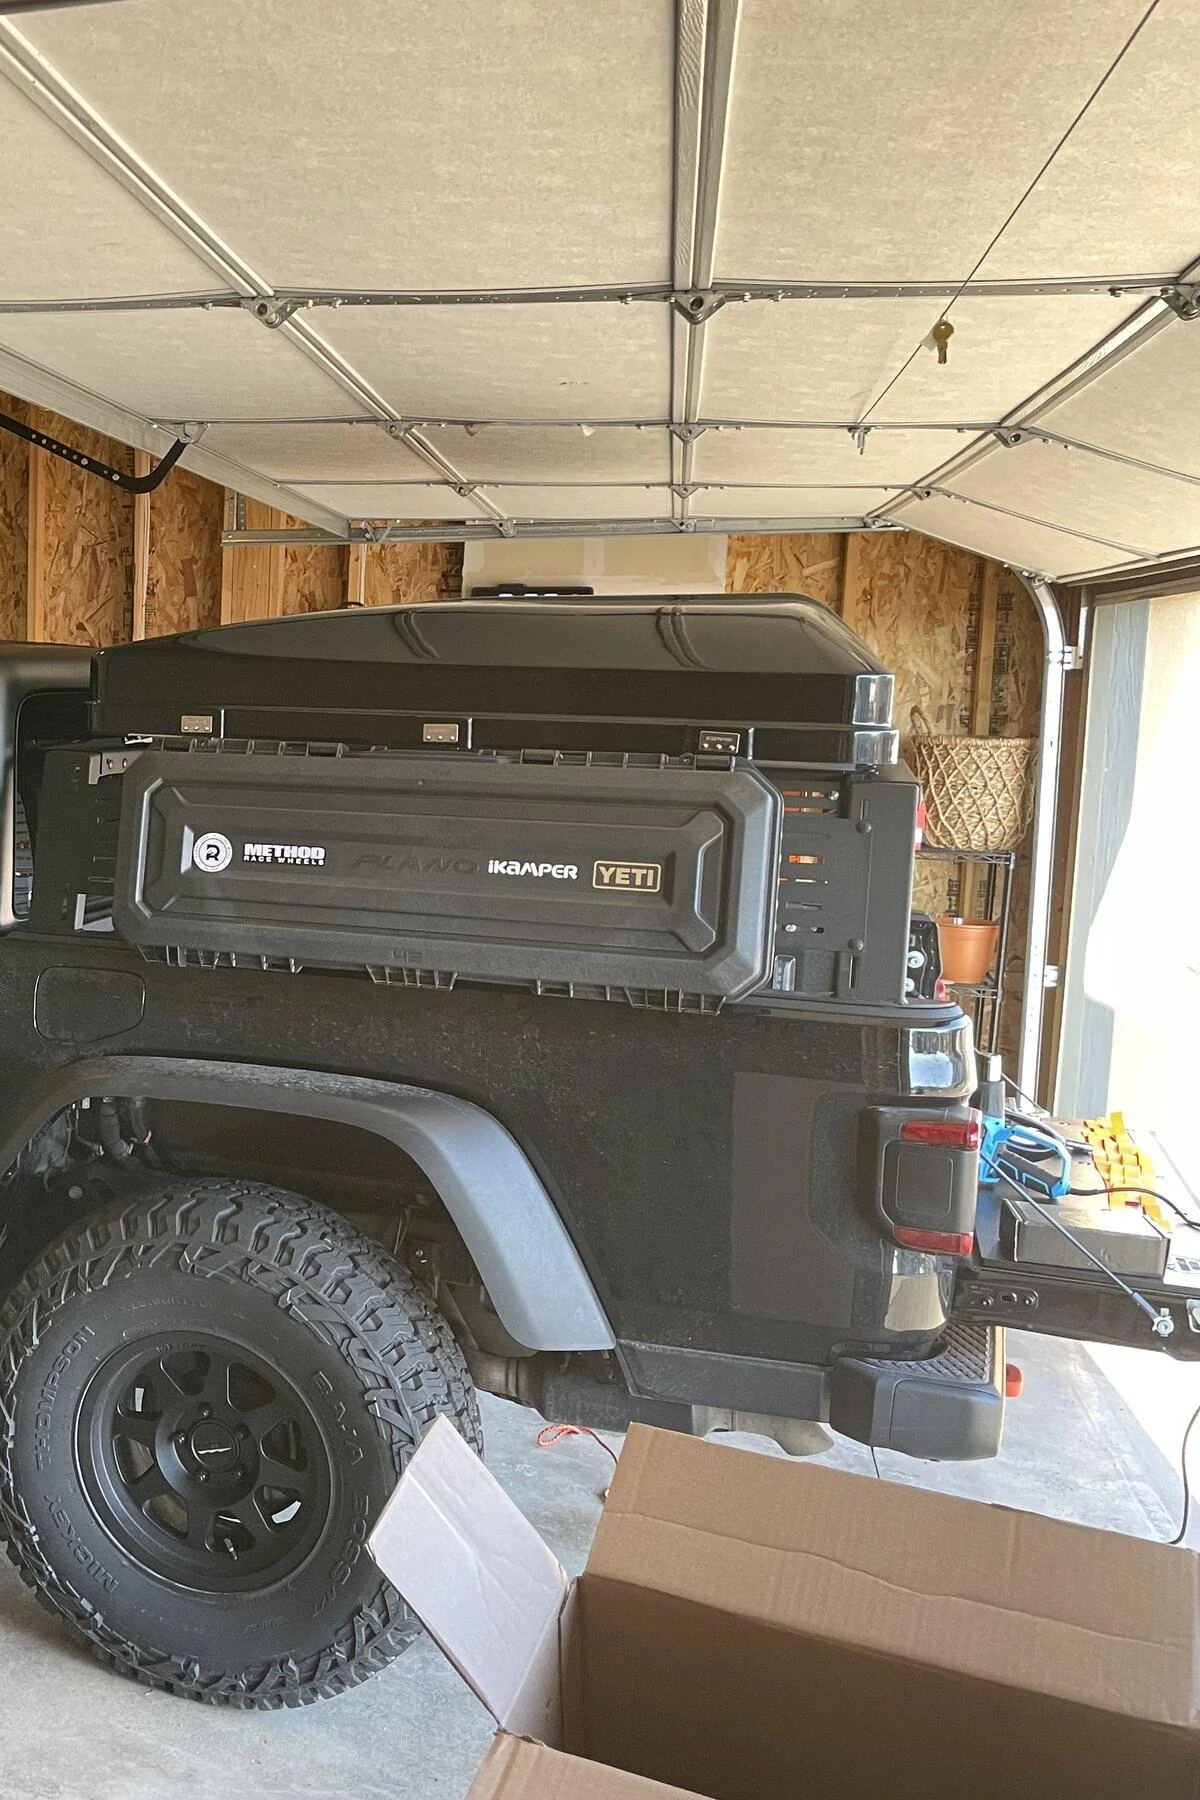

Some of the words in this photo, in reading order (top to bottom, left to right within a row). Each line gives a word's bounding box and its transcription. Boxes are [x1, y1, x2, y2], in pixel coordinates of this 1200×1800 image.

[243, 855, 272, 863] RACE
[278, 857, 325, 866] WHEELS
[244, 843, 326, 860] METHOD
[352, 854, 480, 875] PLANO
[599, 866, 654, 887] YETI
[35, 1325, 95, 1470] THOMPSON
[45, 1494, 121, 1593] MICKEY
